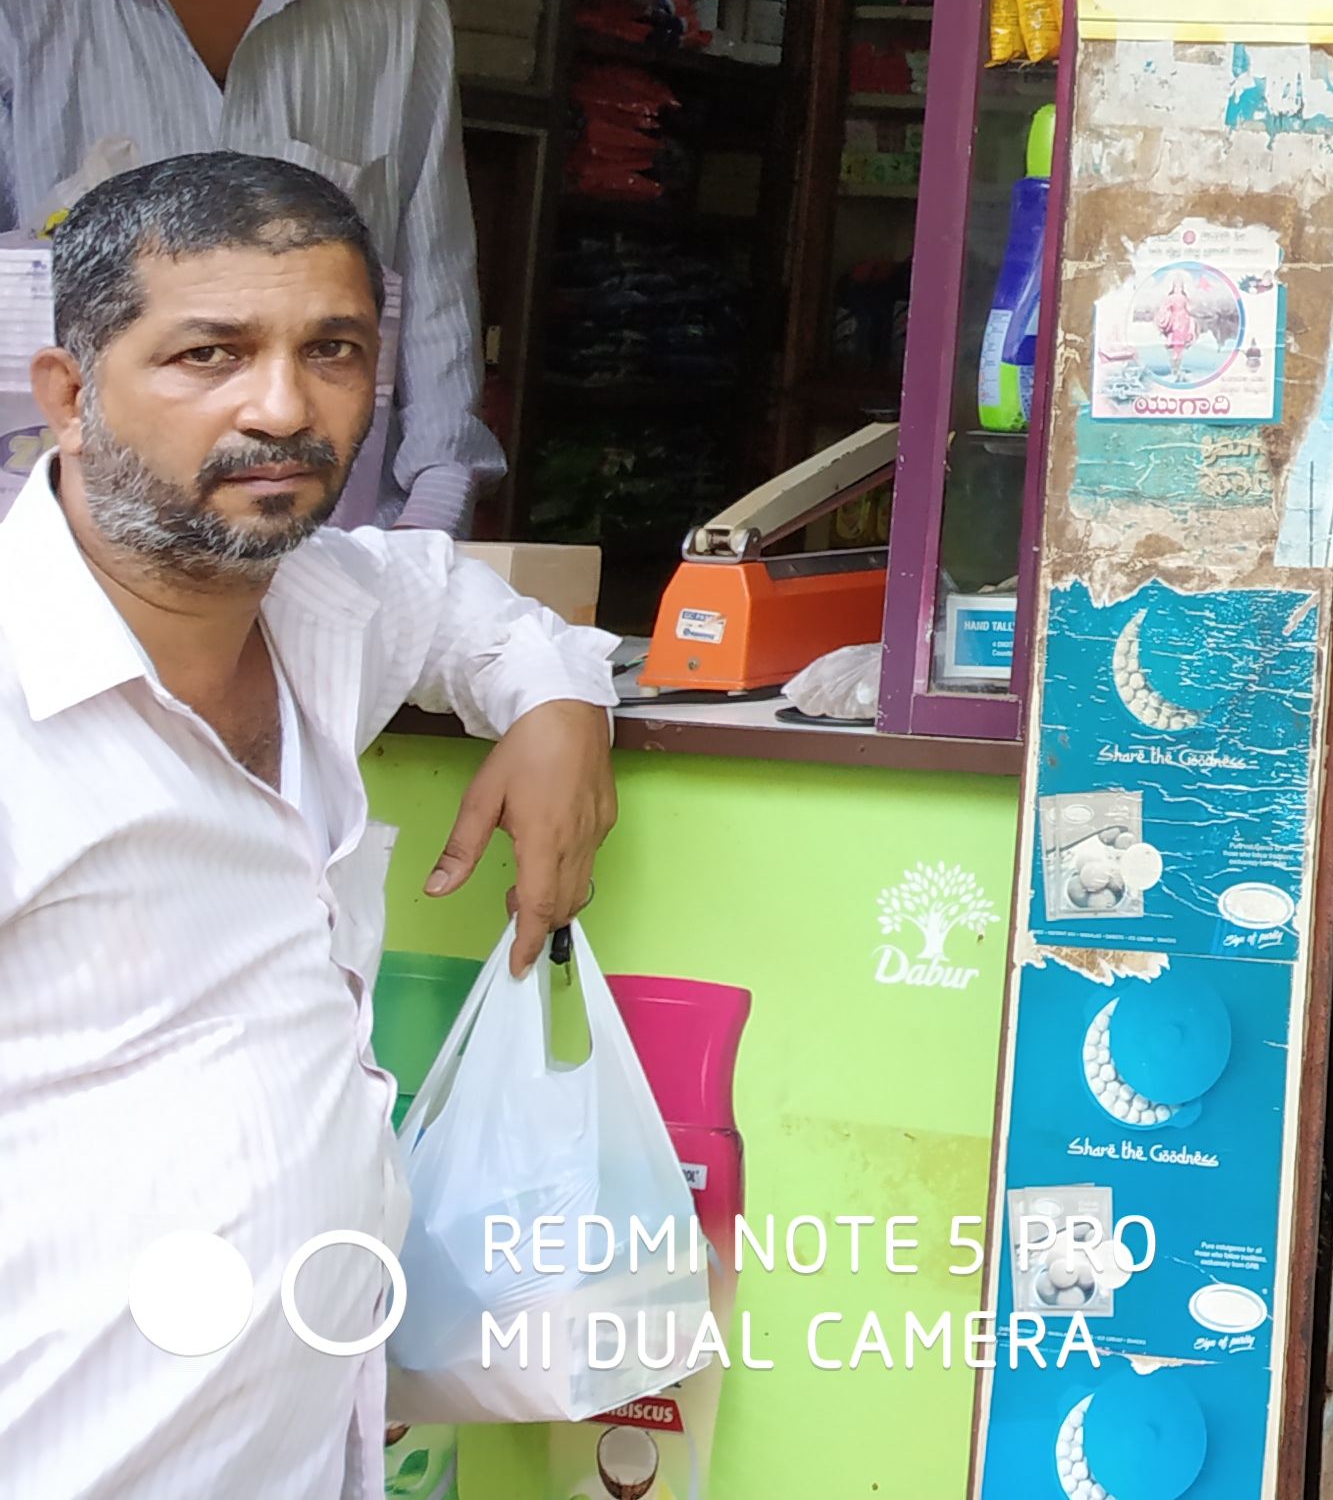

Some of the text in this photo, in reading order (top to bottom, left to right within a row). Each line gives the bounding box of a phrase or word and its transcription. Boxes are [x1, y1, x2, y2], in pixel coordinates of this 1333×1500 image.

[1134, 394, 1232, 415] ಯುಗಾದಿ
[963, 620, 989, 631] HAND
[872, 943, 980, 990] Dabur
